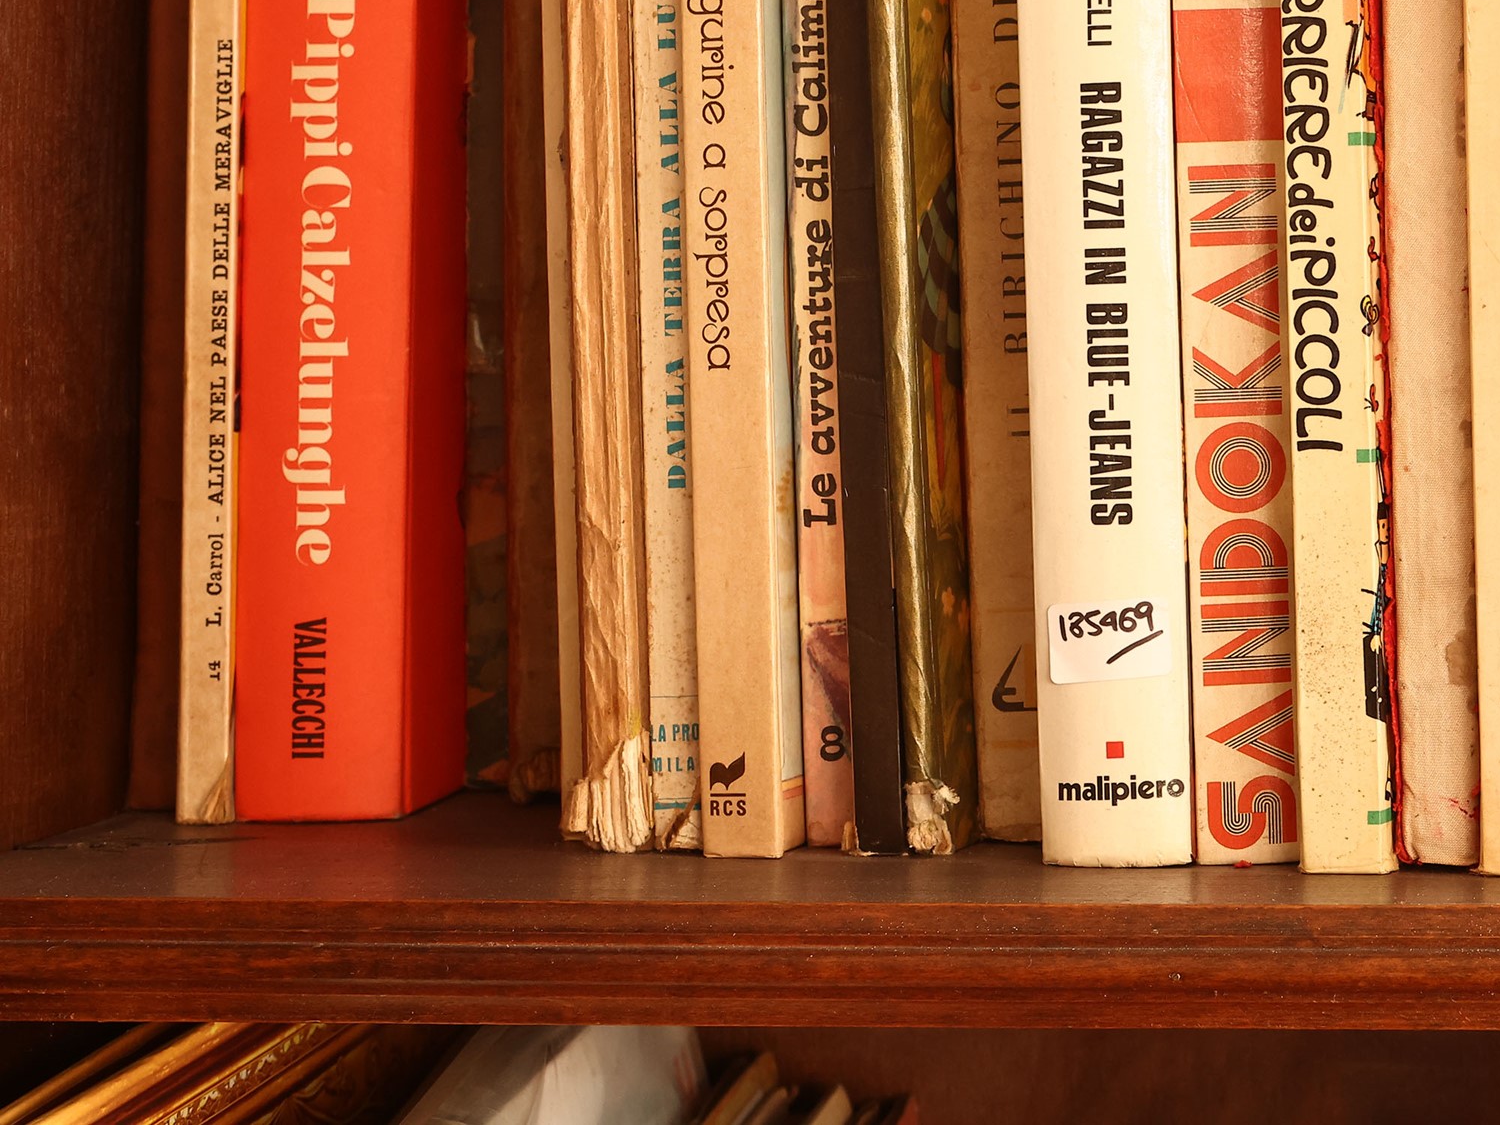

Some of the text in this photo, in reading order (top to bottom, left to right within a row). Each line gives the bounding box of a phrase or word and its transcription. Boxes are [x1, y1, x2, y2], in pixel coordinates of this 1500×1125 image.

[658, 70, 680, 176] ALLA
[702, 143, 727, 171] a
[795, 155, 829, 202] di
[1079, 81, 1126, 230] RAGAZZI
[205, 38, 234, 627] L. Carrol ALICE NEL PAESE DELLE MERAVIGLIE
[661, 195, 684, 336] TERRA
[693, 185, 732, 373] sorpresa
[1084, 247, 1128, 286] IN
[282, 165, 352, 567] Calzelunghe
[802, 219, 837, 455] avventure
[1290, 249, 1343, 452] PICCOLI
[665, 356, 687, 489] DALLA
[1086, 302, 1133, 526] BLUE-JEANS
[804, 472, 837, 527] Le
[1188, 164, 1298, 850] SANDOKAN
[207, 659, 222, 681] 14
[291, 617, 327, 759] VALLECCHI
[710, 798, 747, 817] RCS
[820, 725, 846, 762] 8
[1058, 773, 1185, 806] malipiero
